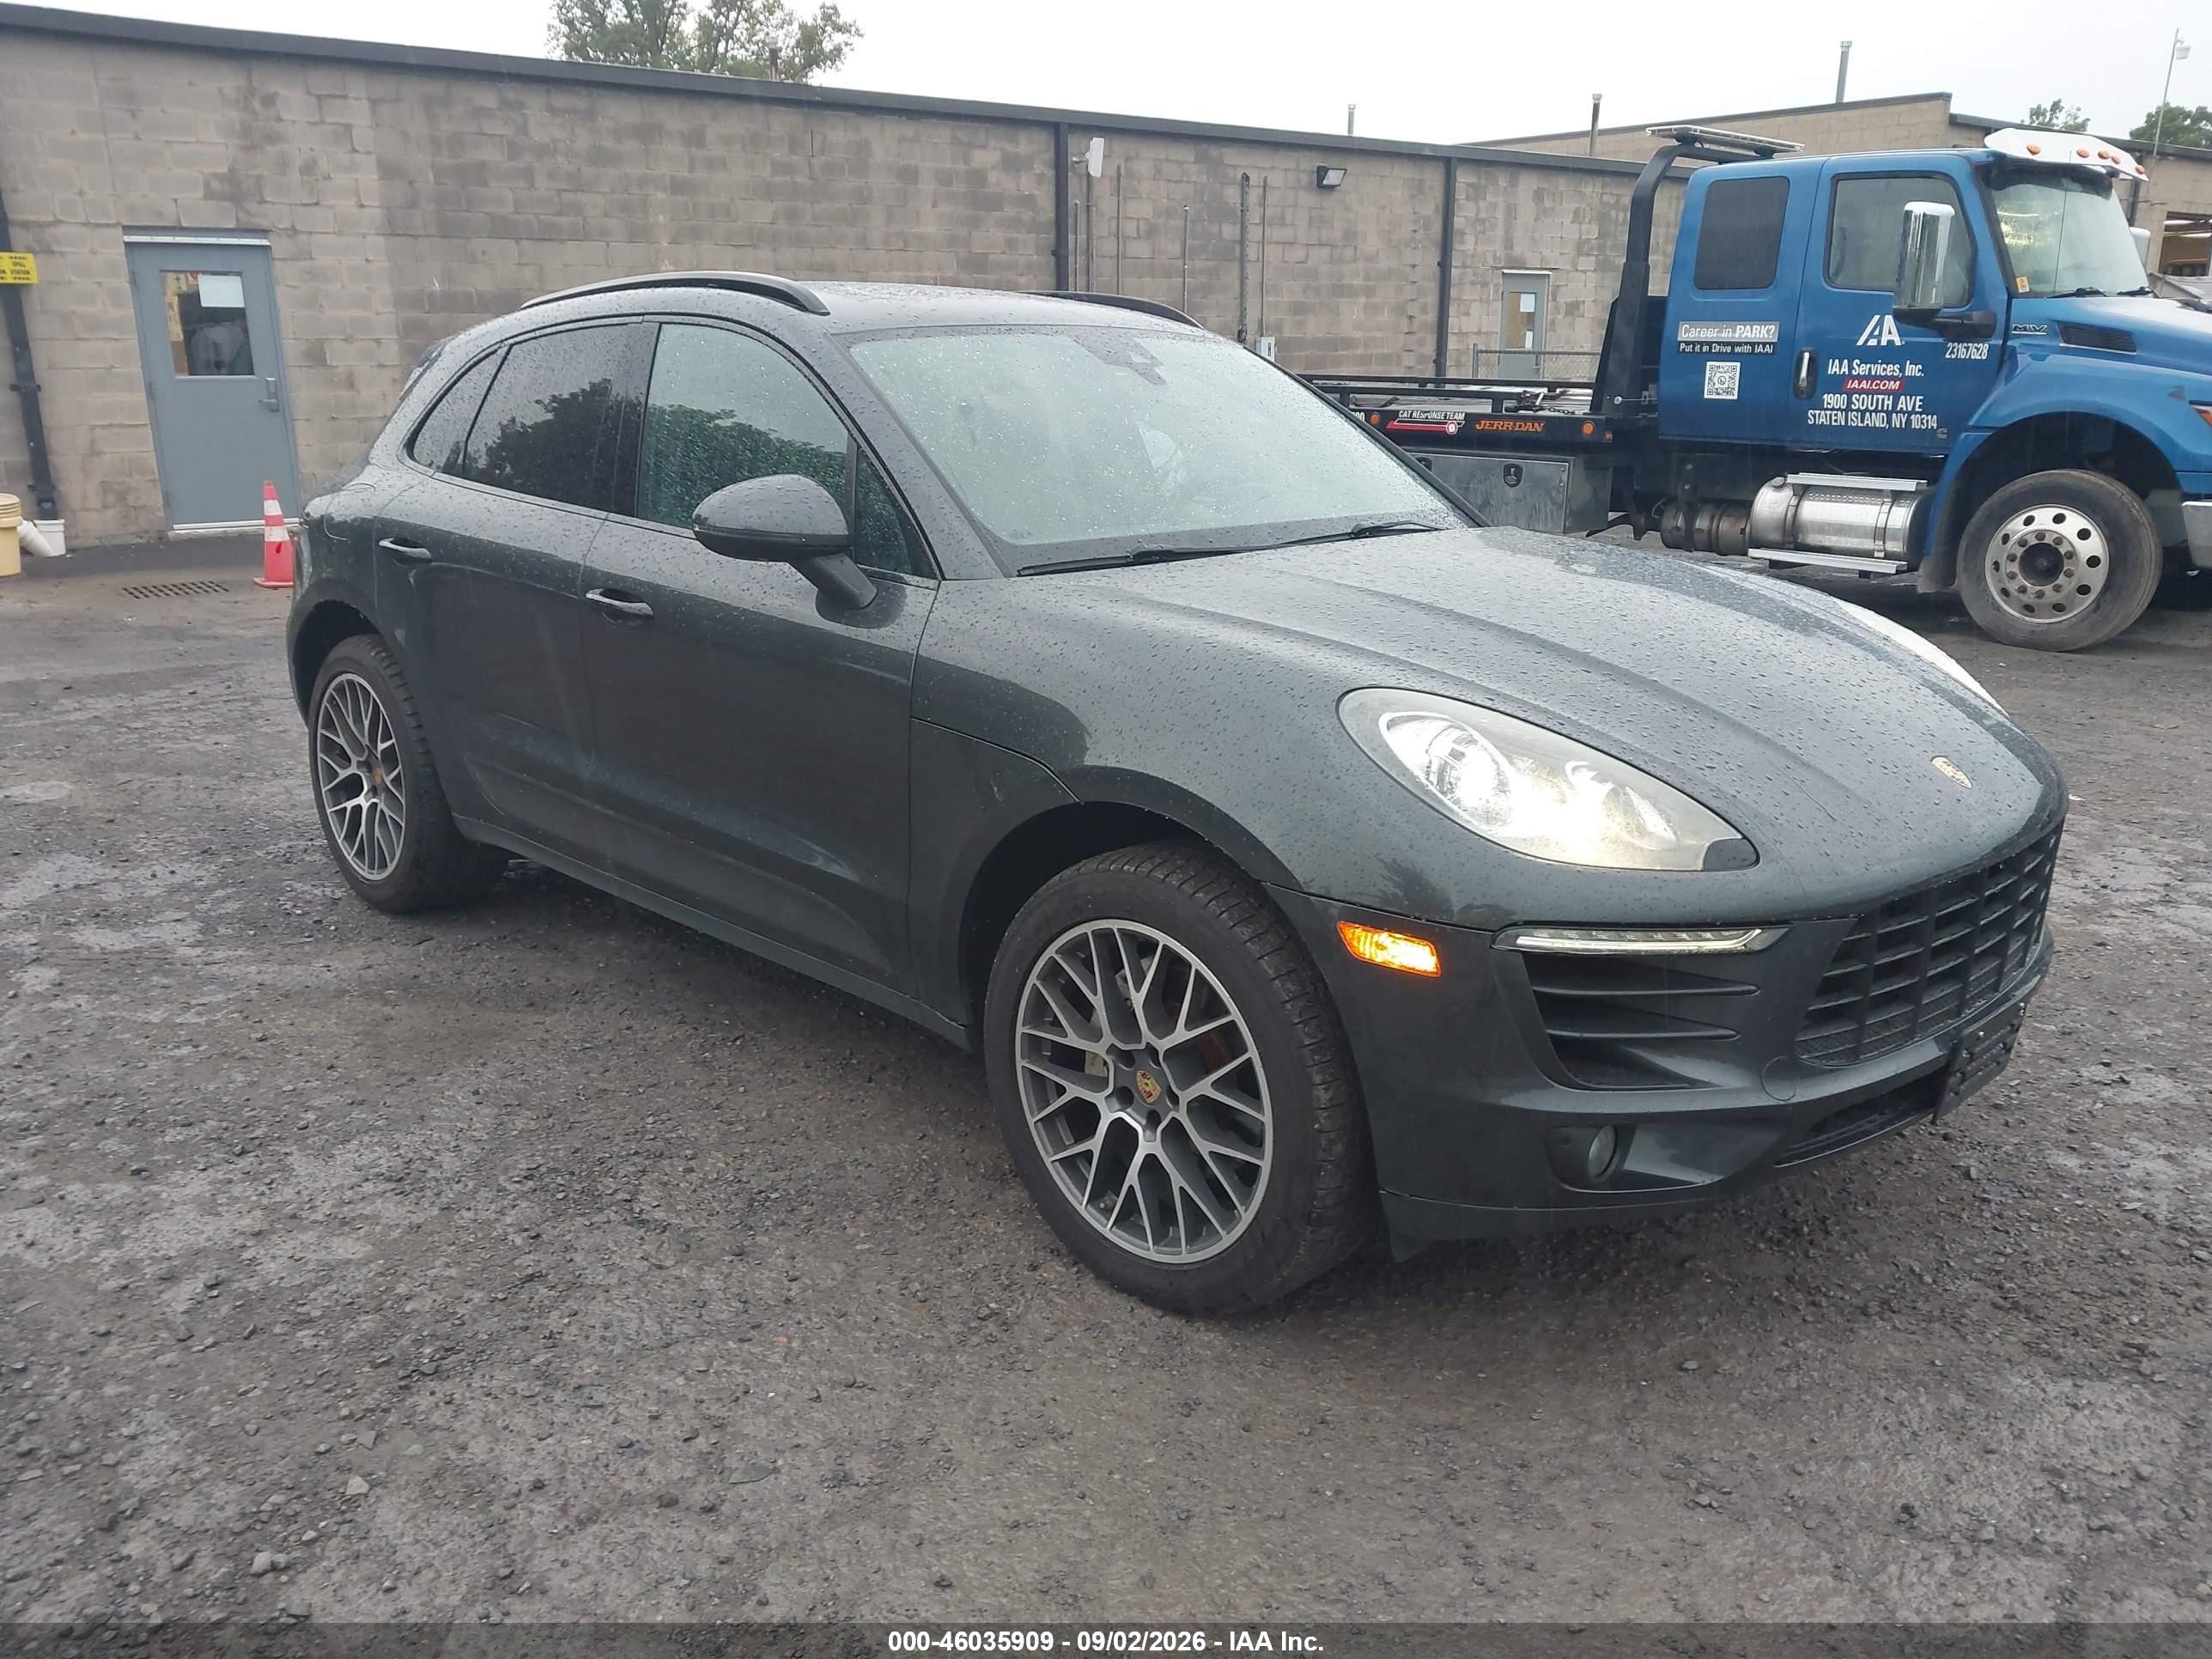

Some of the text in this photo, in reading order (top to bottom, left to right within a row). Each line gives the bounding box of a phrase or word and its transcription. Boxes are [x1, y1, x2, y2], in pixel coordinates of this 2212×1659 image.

[1681, 325, 1776, 338] Career in PARK?
[1680, 343, 1773, 354] Put it in Drive with IAAI
[1945, 342, 1990, 359] 23167628
[1827, 358, 1924, 377] IAA Services, Inc.
[1847, 380, 1901, 390] IAAI.COM
[1822, 393, 1924, 411] 1900 SOUTH AVE
[1412, 410, 1445, 420] RESPONSE
[1808, 410, 1937, 429] STATEN ISLAND, NY 10314
